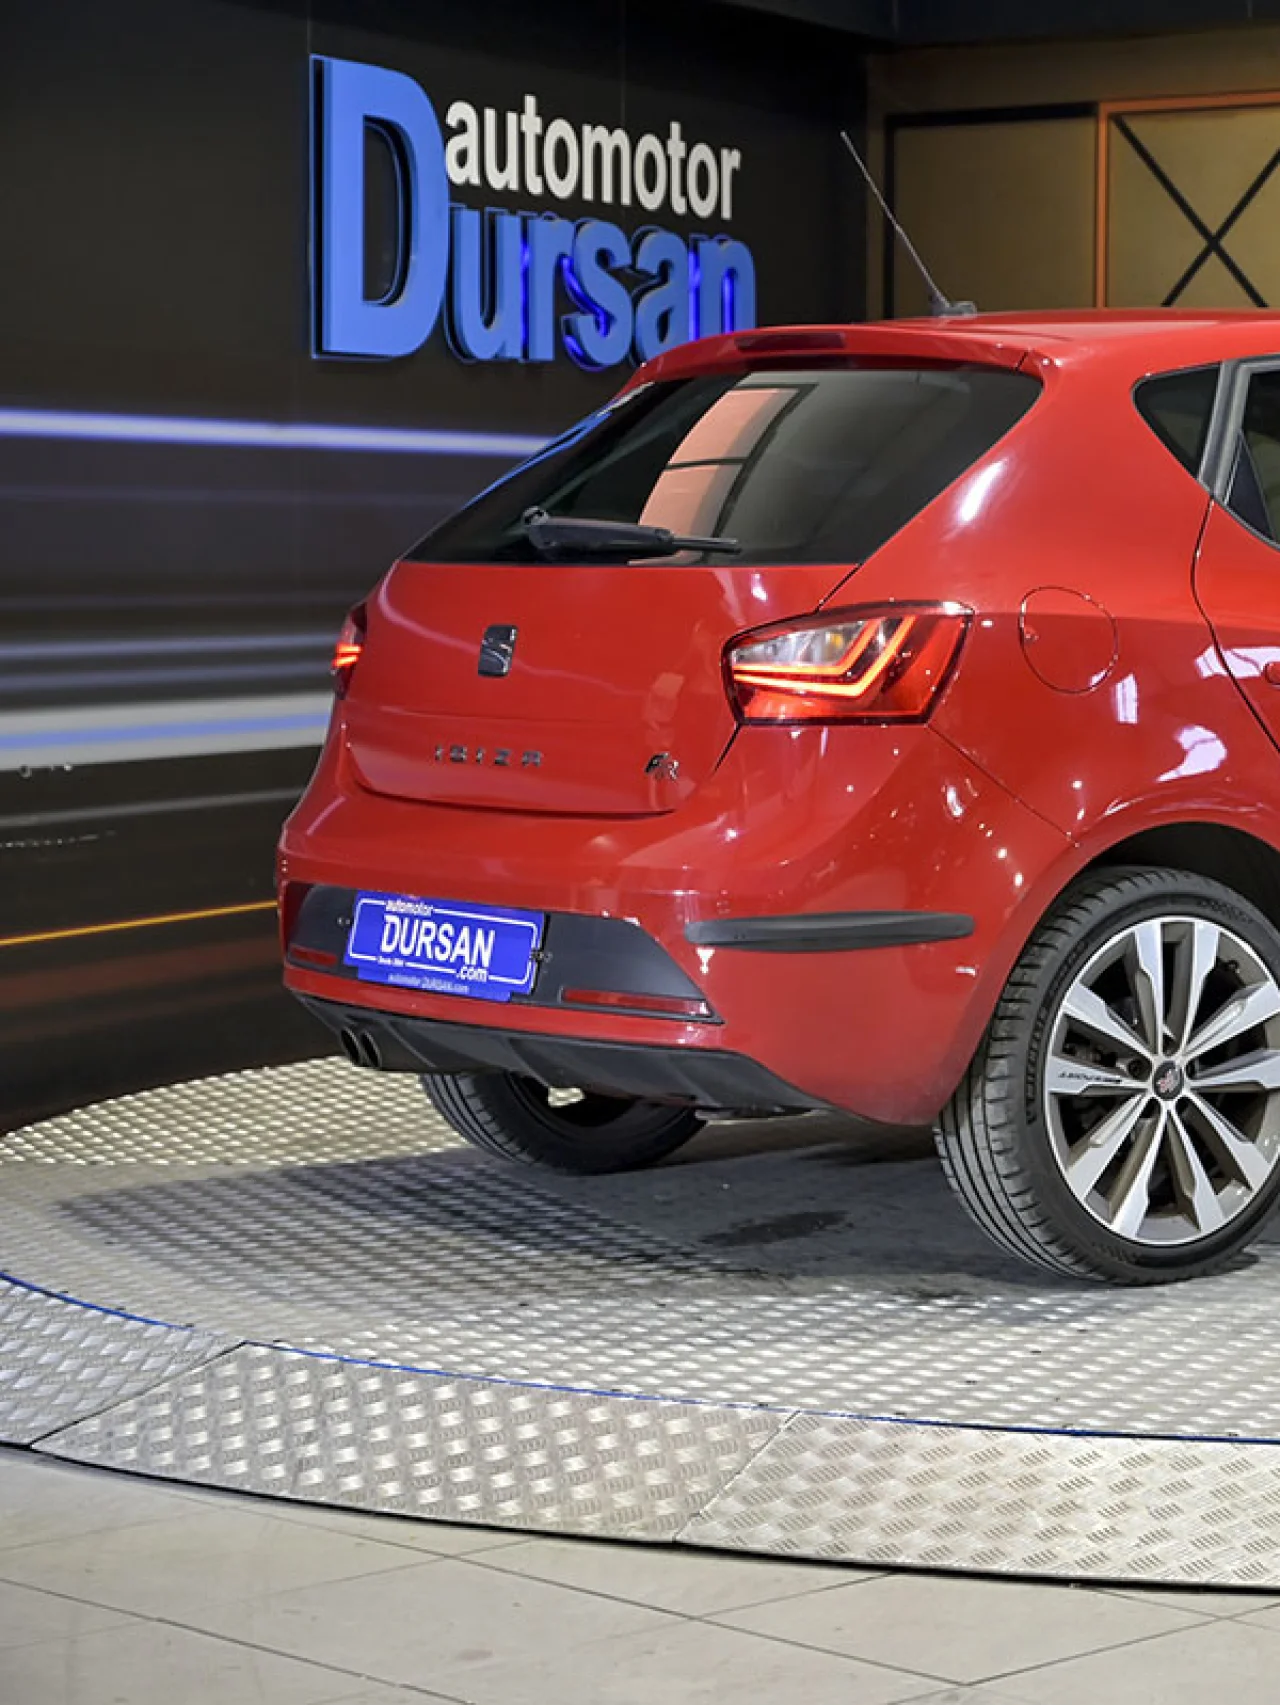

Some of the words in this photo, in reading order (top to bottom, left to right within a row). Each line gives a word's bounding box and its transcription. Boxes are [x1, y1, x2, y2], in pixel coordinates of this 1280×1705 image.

[309, 54, 757, 371] Dursan
[445, 93, 742, 220] automotor
[380, 913, 495, 967] DURSAN
